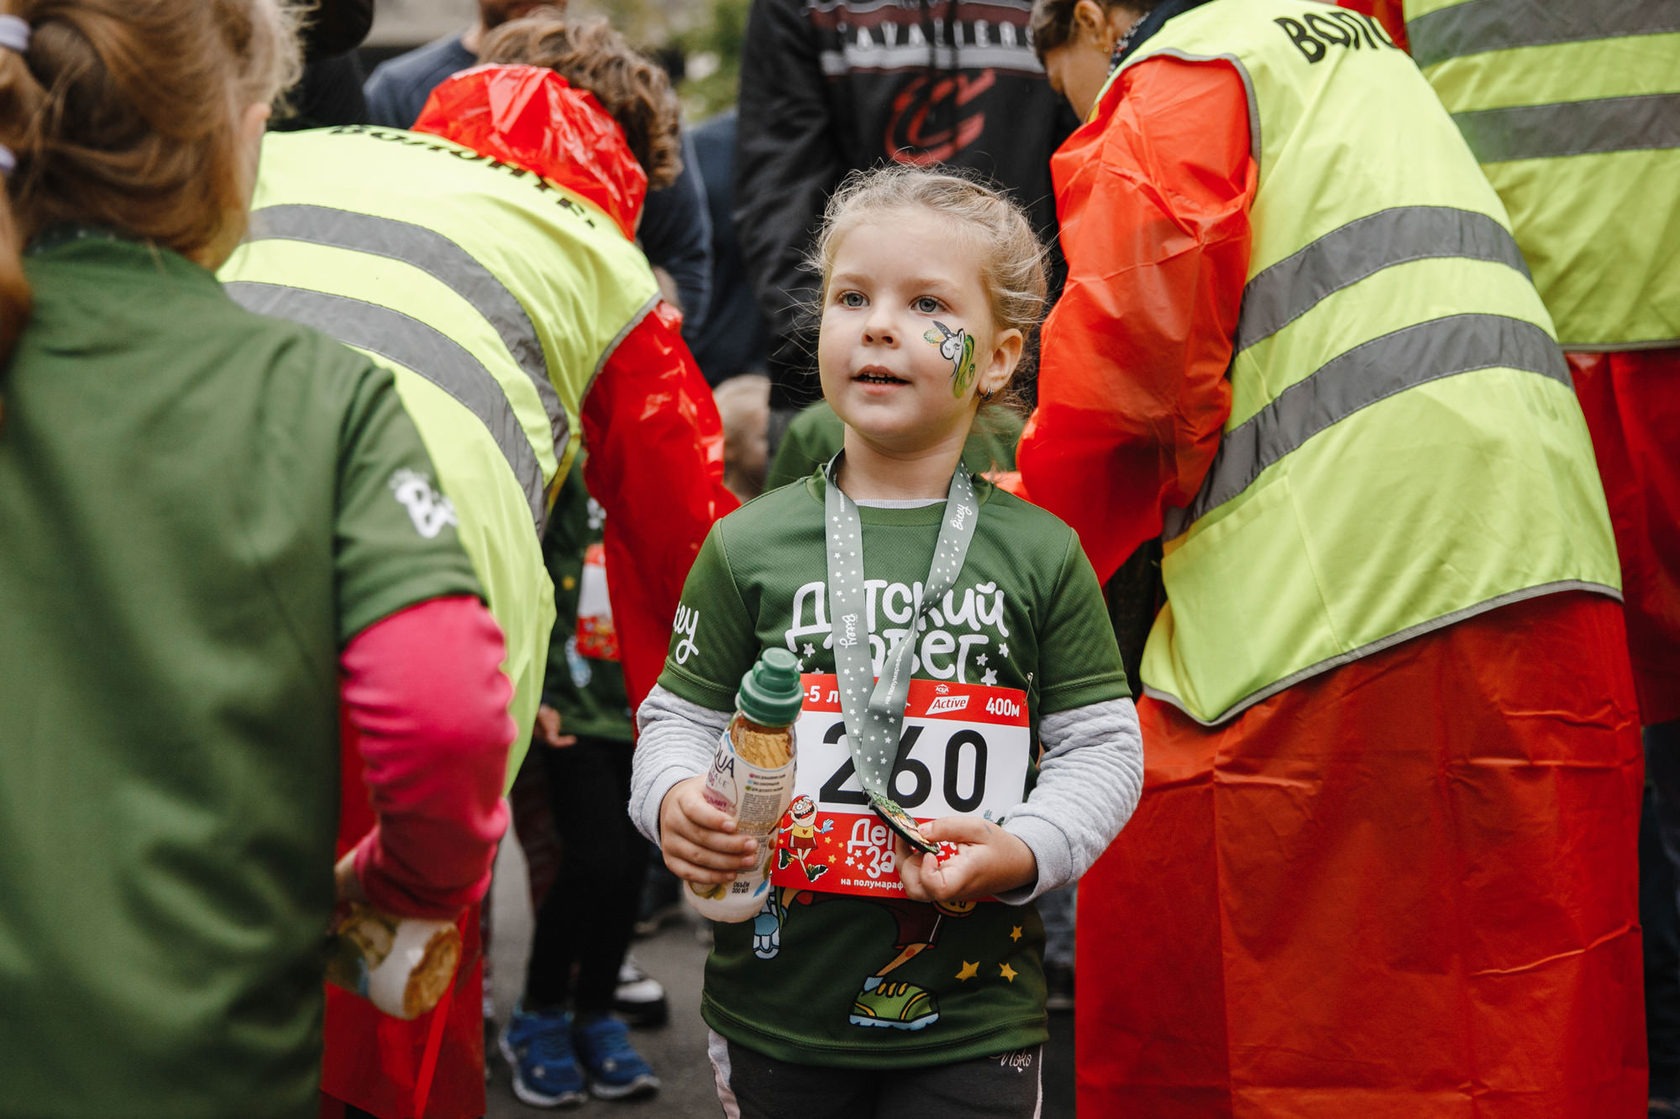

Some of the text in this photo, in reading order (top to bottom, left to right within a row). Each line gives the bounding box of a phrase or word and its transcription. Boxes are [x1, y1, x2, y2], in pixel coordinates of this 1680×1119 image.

[785, 580, 1010, 652] Дтский
[932, 697, 967, 710] Active
[819, 721, 988, 814] 260
[840, 878, 904, 891] на полумараф
